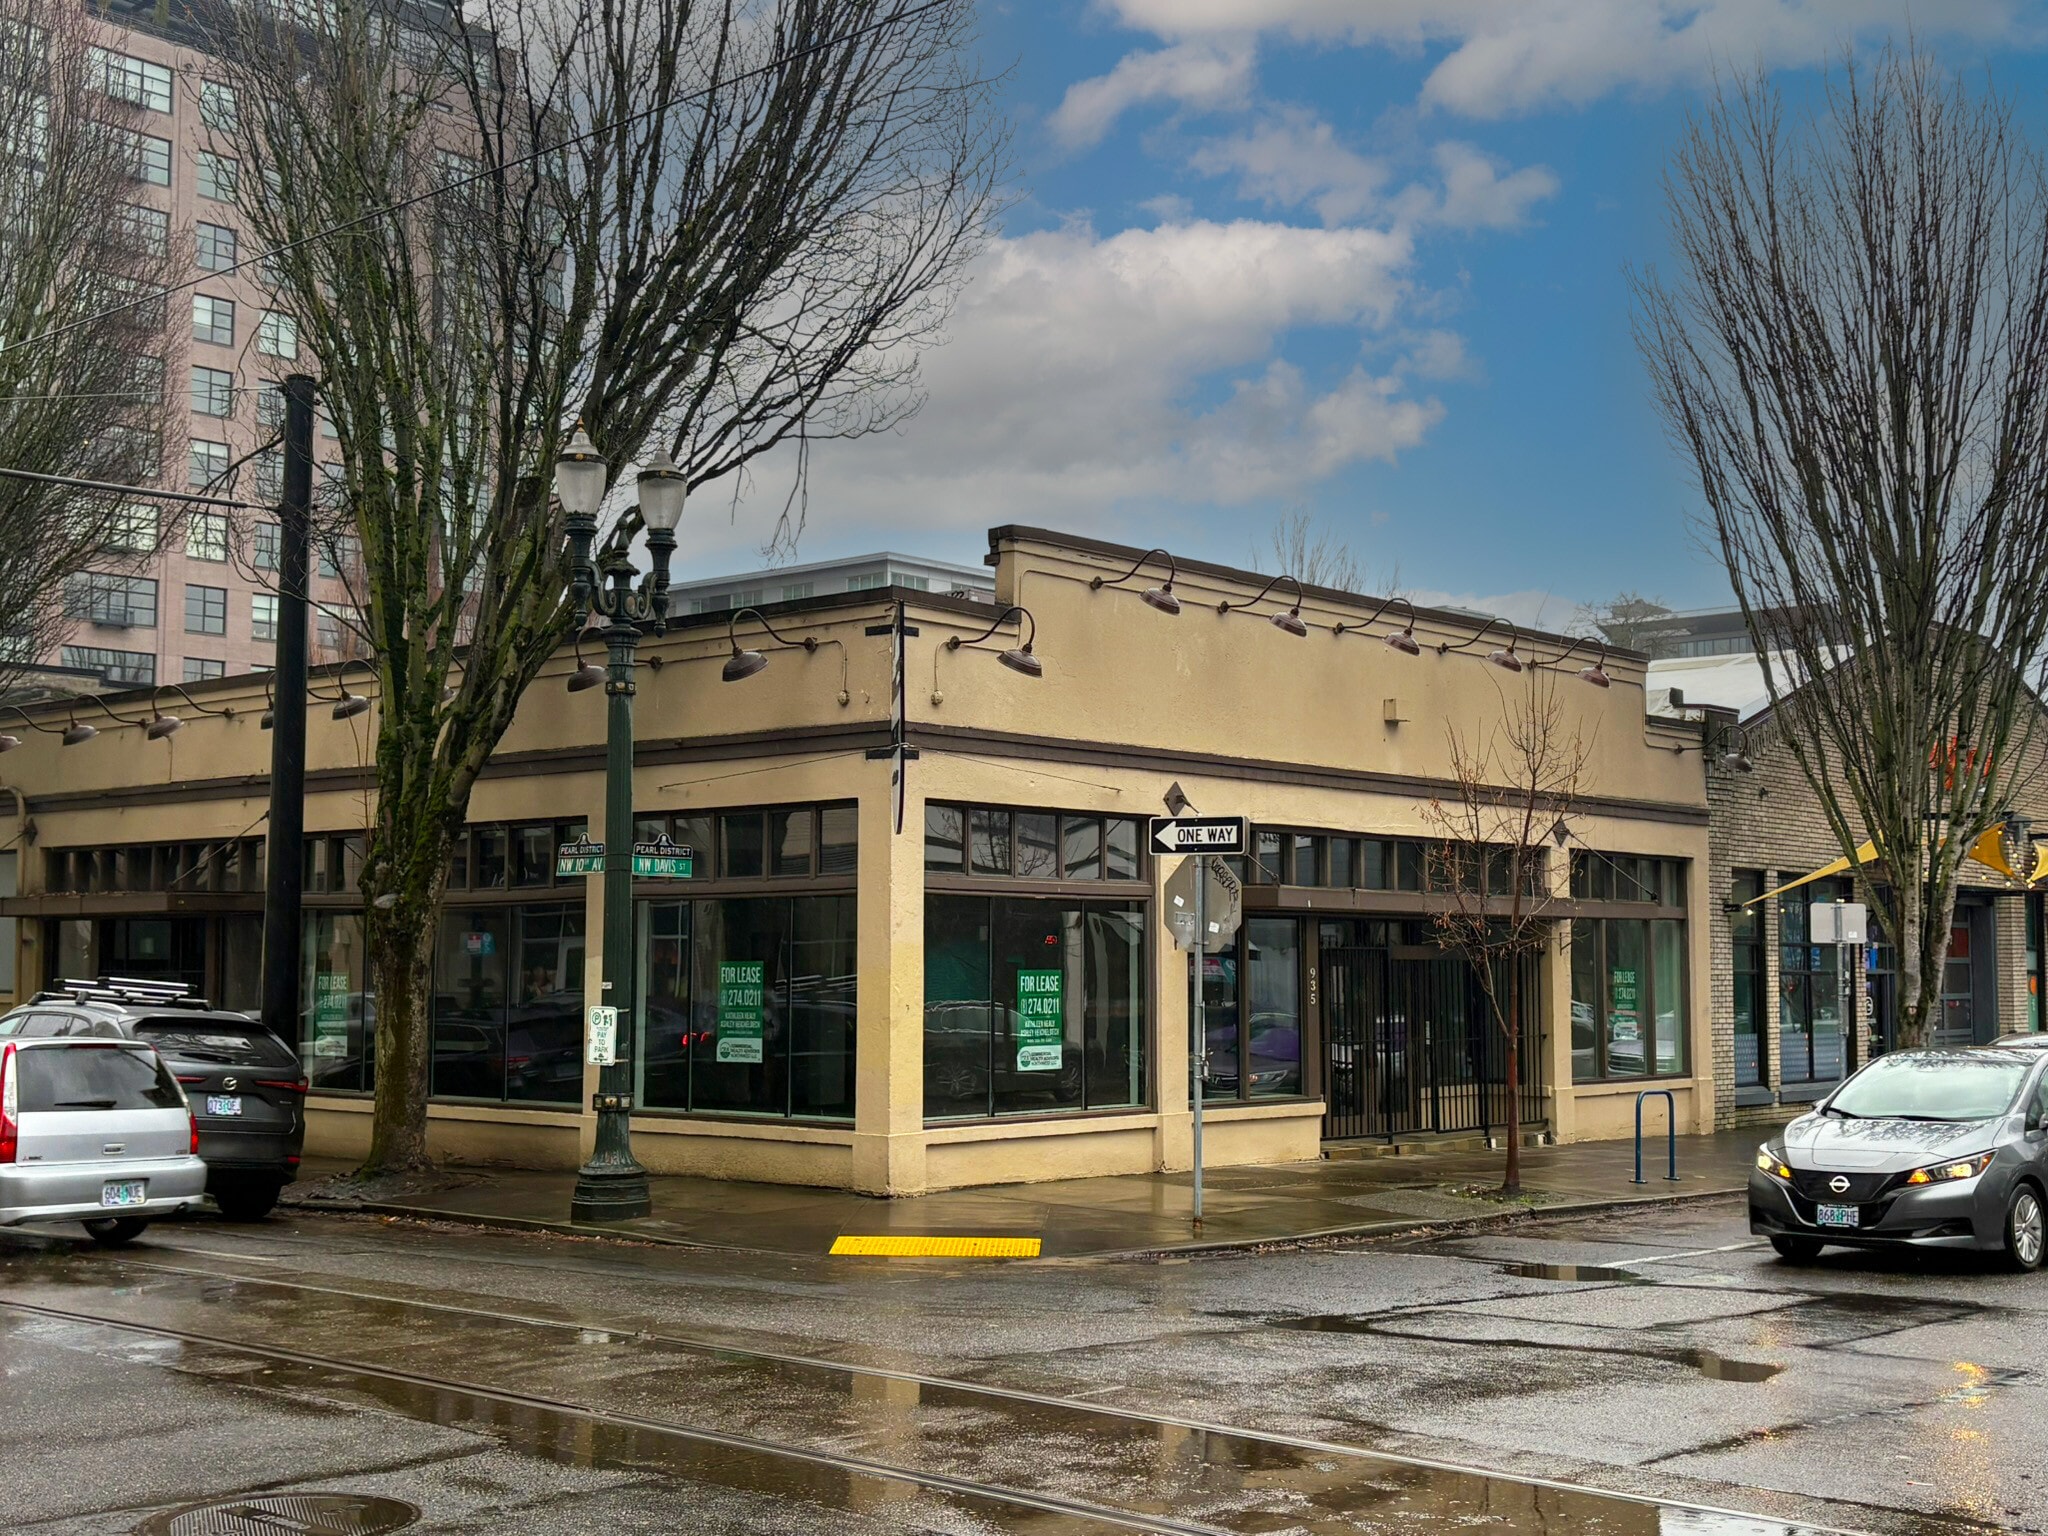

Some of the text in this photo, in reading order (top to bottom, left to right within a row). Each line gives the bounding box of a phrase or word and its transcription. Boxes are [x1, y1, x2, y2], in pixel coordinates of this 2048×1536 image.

[1177, 827, 1234, 842] ONE WAY
[561, 845, 604, 854] PEARL DISTRICT
[636, 846, 691, 856] PEARL DISTRICT
[560, 858, 574, 872] NW
[591, 857, 603, 872] AV
[639, 858, 652, 872] NW
[654, 858, 676, 873] DAVIS
[318, 975, 348, 990] FOR LEASE
[720, 966, 761, 984] FOR LEASE
[1020, 975, 1060, 992] FOR LEASE
[1309, 967, 1317, 1005] 935
[594, 1045, 609, 1053] PARK
[598, 1038, 606, 1046] TO
[104, 1186, 120, 1200] 604
[1818, 1208, 1859, 1224] 868 PHE
